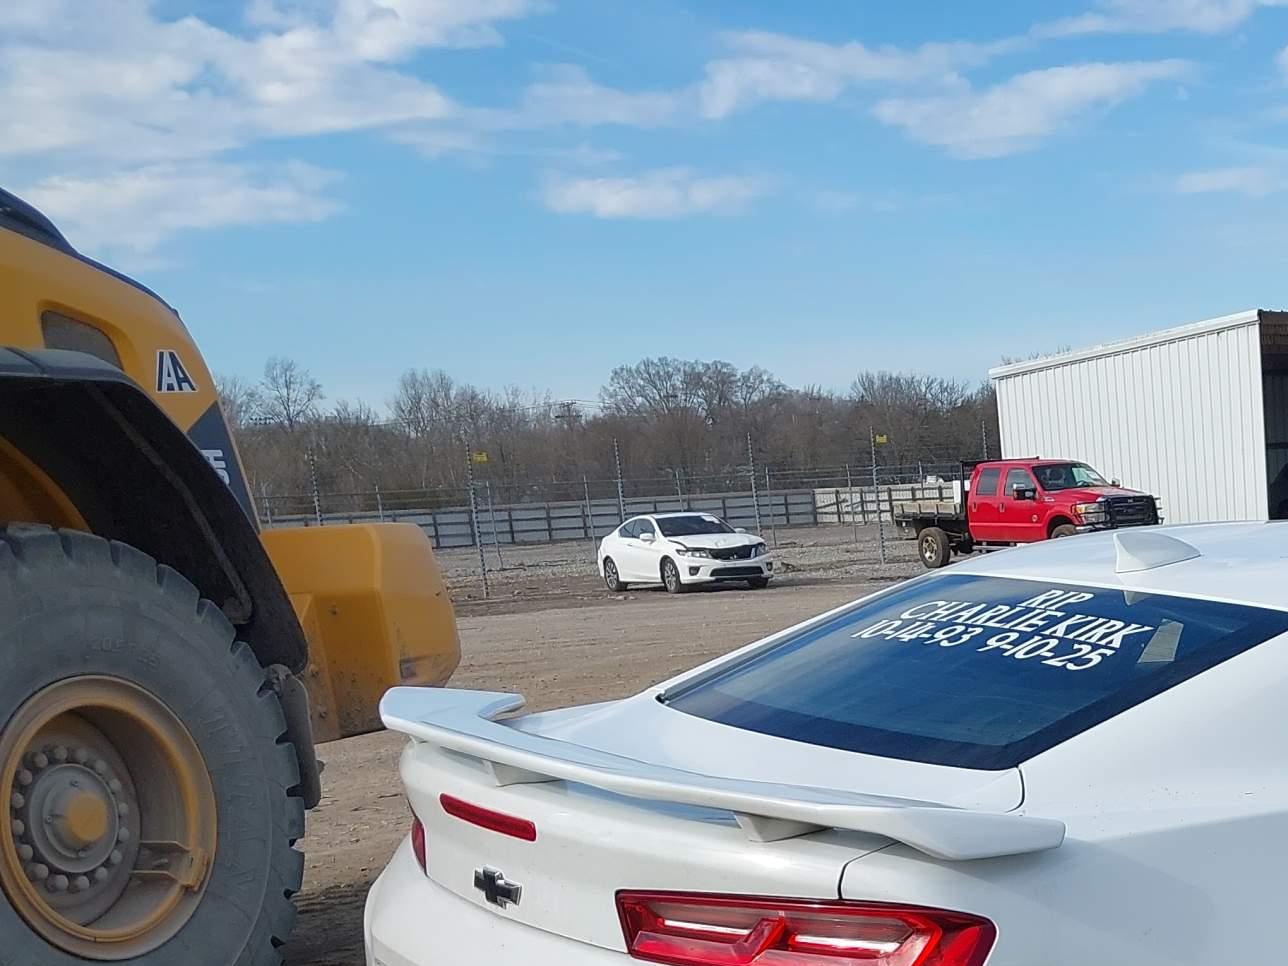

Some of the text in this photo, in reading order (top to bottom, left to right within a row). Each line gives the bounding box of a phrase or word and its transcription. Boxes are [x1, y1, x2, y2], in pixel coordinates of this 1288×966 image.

[156, 350, 198, 392] IAA
[1017, 589, 1095, 611] RIP
[849, 619, 1116, 671] 10-14-93 9-10-25
[900, 600, 1154, 649] CHARLIE KIRK
